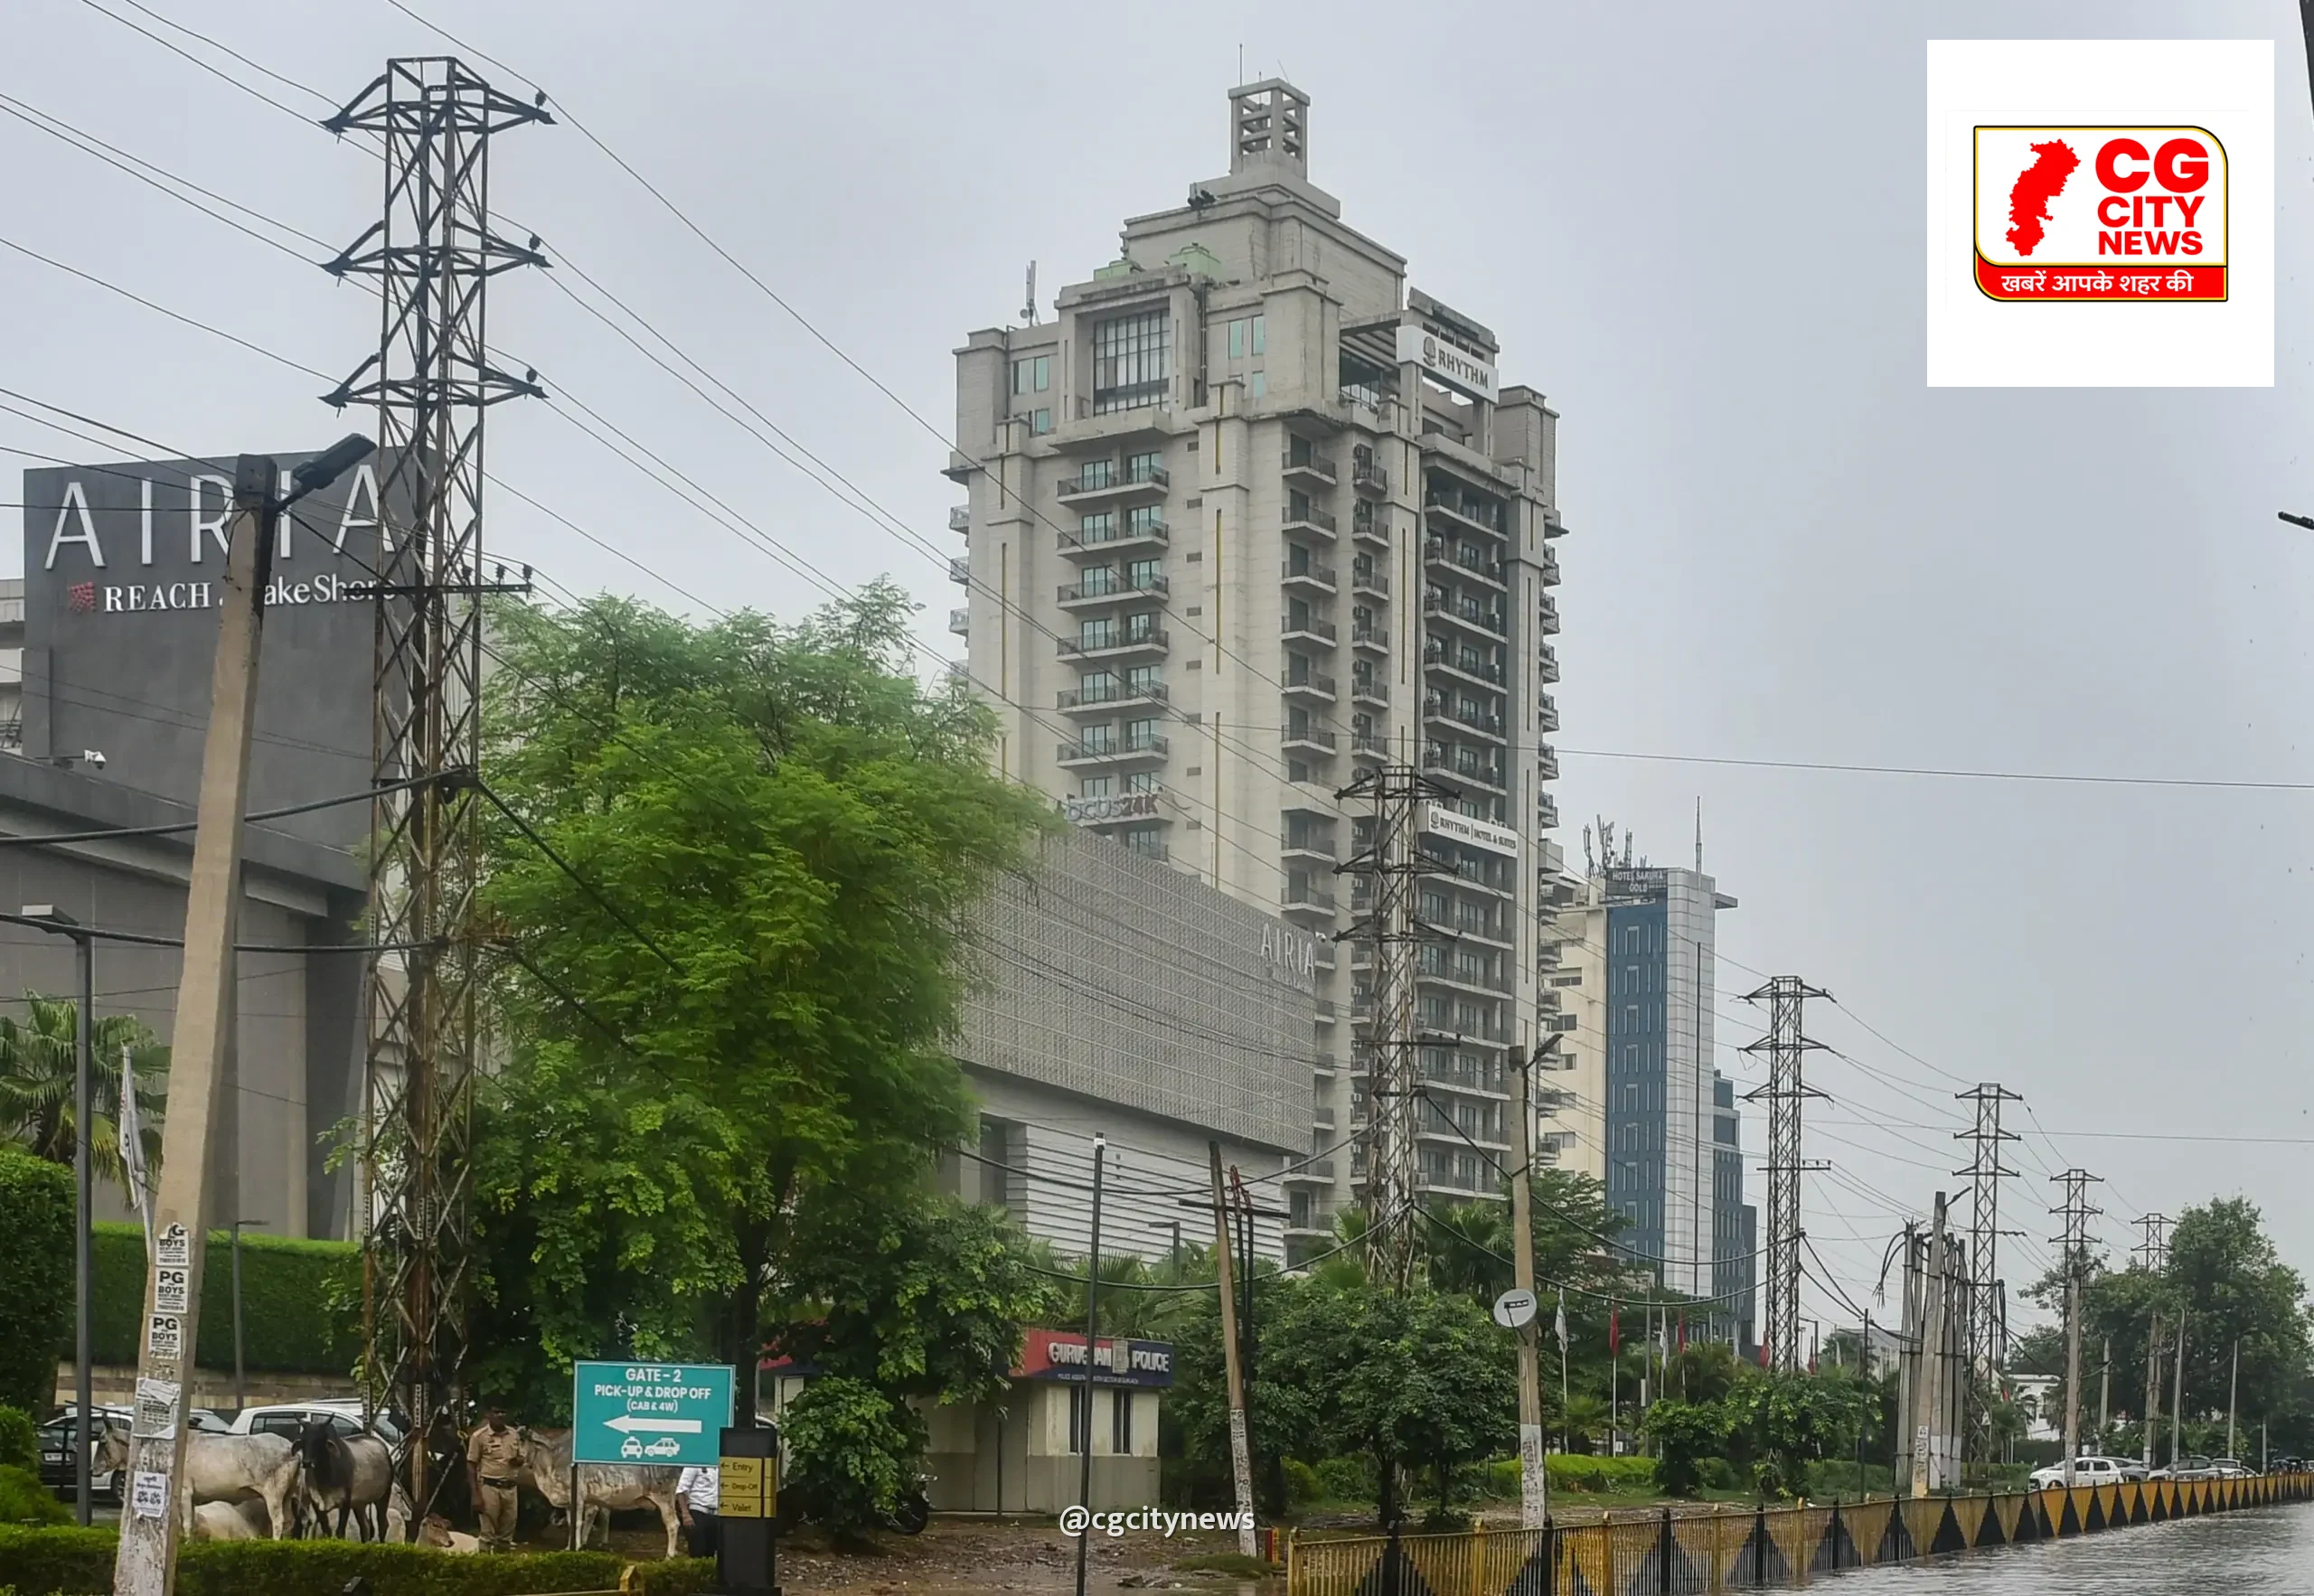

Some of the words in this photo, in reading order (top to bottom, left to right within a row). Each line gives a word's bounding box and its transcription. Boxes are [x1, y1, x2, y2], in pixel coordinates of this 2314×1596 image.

[1437, 347, 1489, 390] RHYTHM
[44, 464, 395, 570] AIRIA
[103, 582, 212, 614] REACH
[263, 572, 397, 606] akeShor
[1440, 816, 1471, 836] RHYTHM
[1612, 870, 1634, 881] HOTEL
[1629, 882, 1648, 893] GOLD
[1260, 923, 1315, 983] AIRIA
[159, 1238, 185, 1247] BOYS
[159, 1270, 184, 1284] PG
[158, 1285, 184, 1294] BOYS
[153, 1317, 177, 1330] PG
[152, 1331, 177, 1341] BOYS
[1048, 1342, 1113, 1367] GURUGAM
[1132, 1349, 1170, 1373] POLICE
[626, 1368, 663, 1383] GATE
[673, 1369, 682, 1383] 2
[594, 1385, 644, 1398] PICK-UP
[645, 1387, 654, 1397] &
[655, 1386, 688, 1399] DROP
[690, 1387, 711, 1400] OFF
[626, 1399, 650, 1412] (CAB
[651, 1401, 658, 1411] &
[659, 1400, 679, 1413] 4W)
[732, 1461, 754, 1474] Entry
[732, 1502, 752, 1512] Valet
